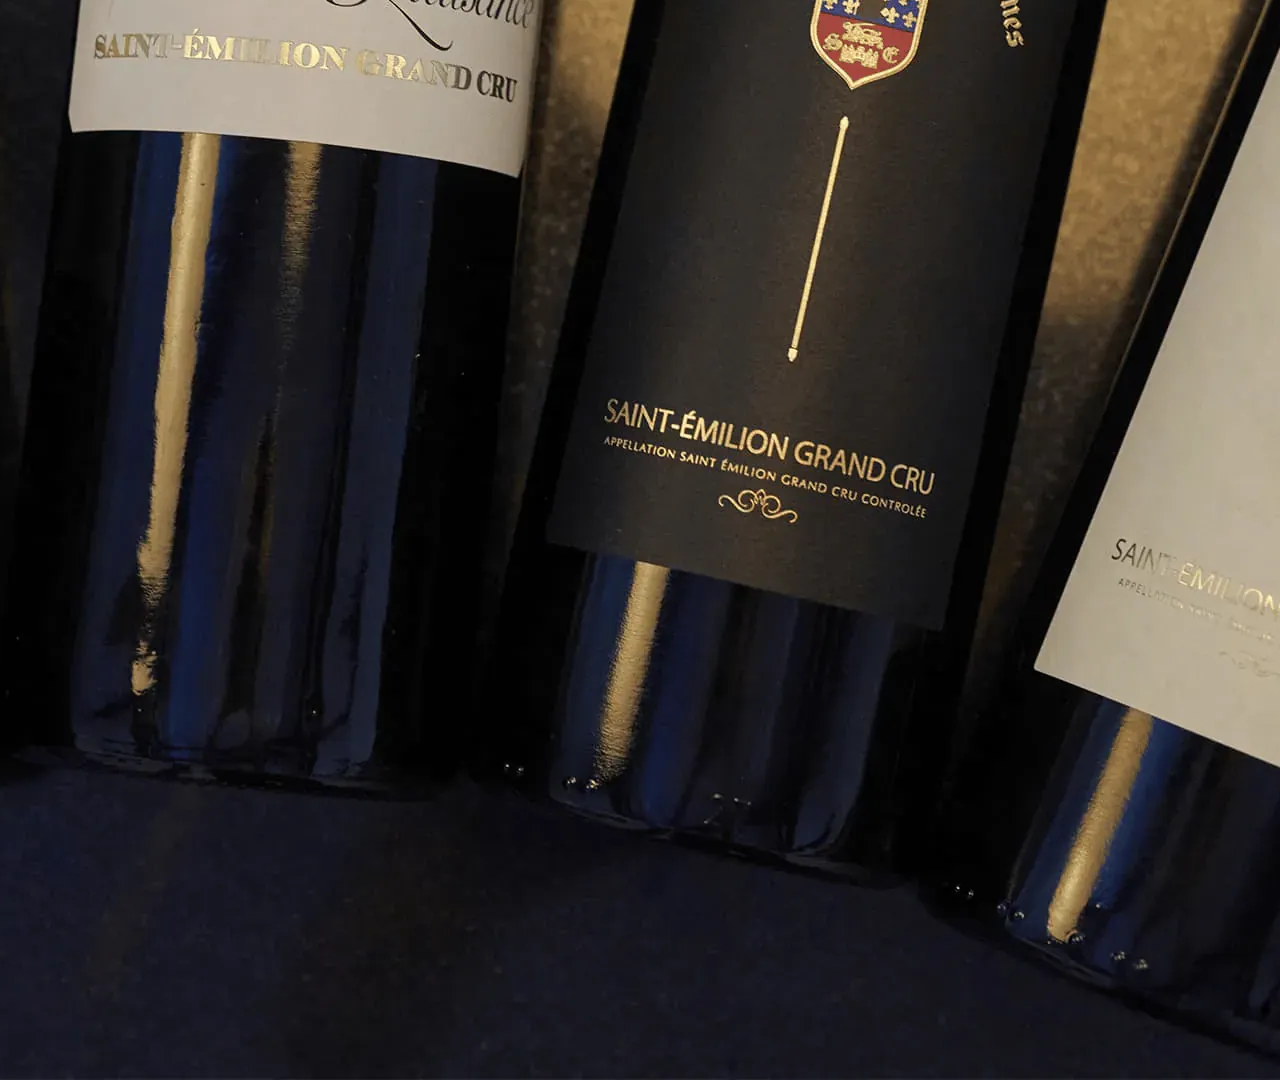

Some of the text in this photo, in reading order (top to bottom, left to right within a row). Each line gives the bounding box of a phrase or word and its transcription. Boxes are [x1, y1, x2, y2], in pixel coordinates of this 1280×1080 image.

[356, 48, 472, 92] GRAND
[476, 70, 518, 103] CRU
[603, 397, 936, 496] SAINT-ÉMILION GRAND CRU
[603, 436, 676, 460] APPELLATION
[679, 451, 717, 469] SAINT
[720, 458, 777, 482] ÉMILION
[780, 473, 828, 494] GRAND
[831, 485, 859, 502] CRU
